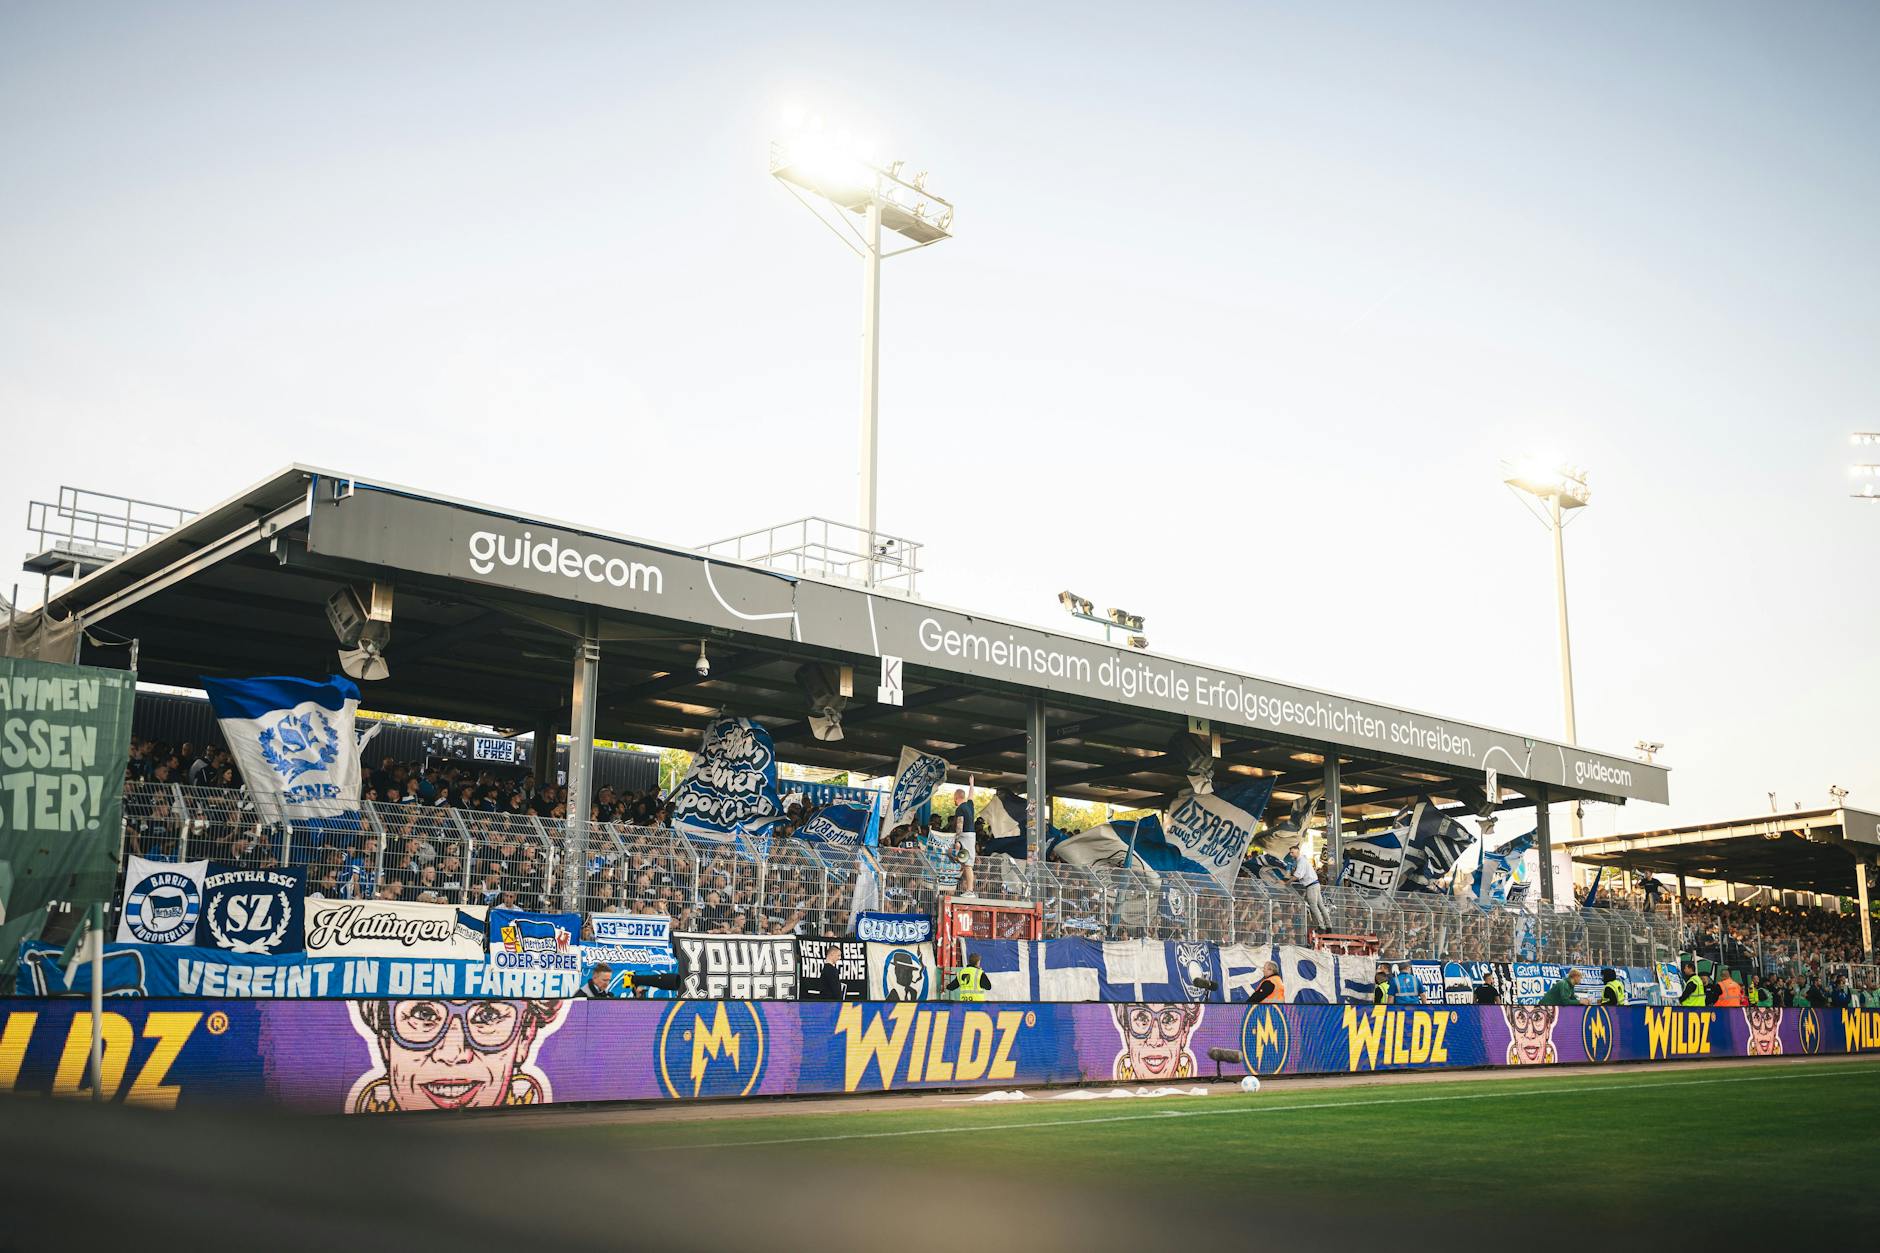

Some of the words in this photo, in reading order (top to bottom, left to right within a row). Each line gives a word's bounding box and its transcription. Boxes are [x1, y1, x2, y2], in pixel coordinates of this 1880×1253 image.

[469, 531, 663, 594] guidecom
[885, 658, 899, 690] K
[919, 618, 1091, 682] Gemeinsam
[1098, 656, 1189, 702] digitale
[1196, 676, 1386, 740] Erfolgsgeschichten
[1391, 720, 1476, 758] schreiben.
[0, 718, 97, 771] SSEN
[476, 738, 513, 751] YOUNG
[1575, 759, 1632, 787] guidecom
[0, 771, 104, 832] TER!
[150, 874, 189, 888] BARRIO
[205, 870, 265, 891] HERTHA
[267, 872, 297, 890] BSC
[225, 894, 274, 932] SZ
[307, 905, 450, 950] Hattingen
[627, 923, 666, 937] CREW
[496, 952, 577, 970] ODER-SPREE
[681, 939, 794, 974] YOUNG
[842, 943, 865, 959] BSC
[178, 958, 337, 998] VEREINT
[343, 961, 378, 995] IN
[389, 962, 458, 996] DEN
[465, 963, 582, 999] FARBEN
